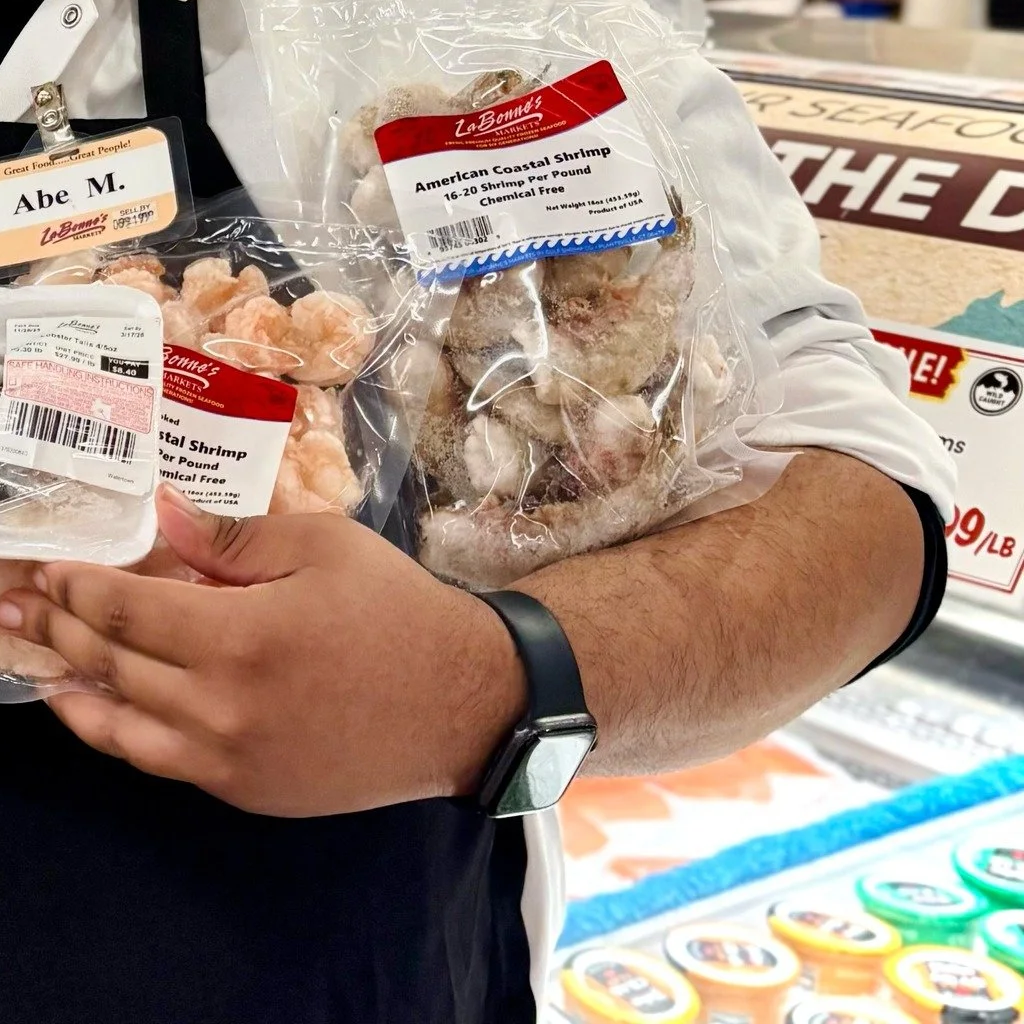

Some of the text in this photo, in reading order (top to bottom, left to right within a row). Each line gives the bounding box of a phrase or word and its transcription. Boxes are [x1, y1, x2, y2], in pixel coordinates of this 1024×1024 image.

[495, 121, 540, 136] MARKETS
[788, 99, 1024, 145] SEAFO
[4, 166, 29, 176] Great
[98, 139, 131, 155] People!
[415, 146, 611, 193] American Coastal Shrimp
[771, 139, 962, 221] THE
[13, 171, 125, 216] Abe M.
[443, 165, 592, 201] 16-20 Shrimp Per Pound
[479, 186, 565, 207] Chemical Free
[560, 201, 586, 210] Weight
[588, 207, 617, 215] Product
[628, 198, 644, 206] USA
[119, 204, 151, 217] SELL BY
[9, 360, 155, 396] SAFE HANDLING INSTRUCTIONS
[111, 365, 137, 376] $8.40
[176, 386, 197, 398] FROZEN
[198, 396, 225, 408] SEAFOOD
[979, 396, 1006, 406] CAUGHT
[986, 391, 1004, 399] WILD
[188, 440, 247, 461] Shrimp
[178, 456, 220, 470] Pound
[199, 475, 226, 484] Free
